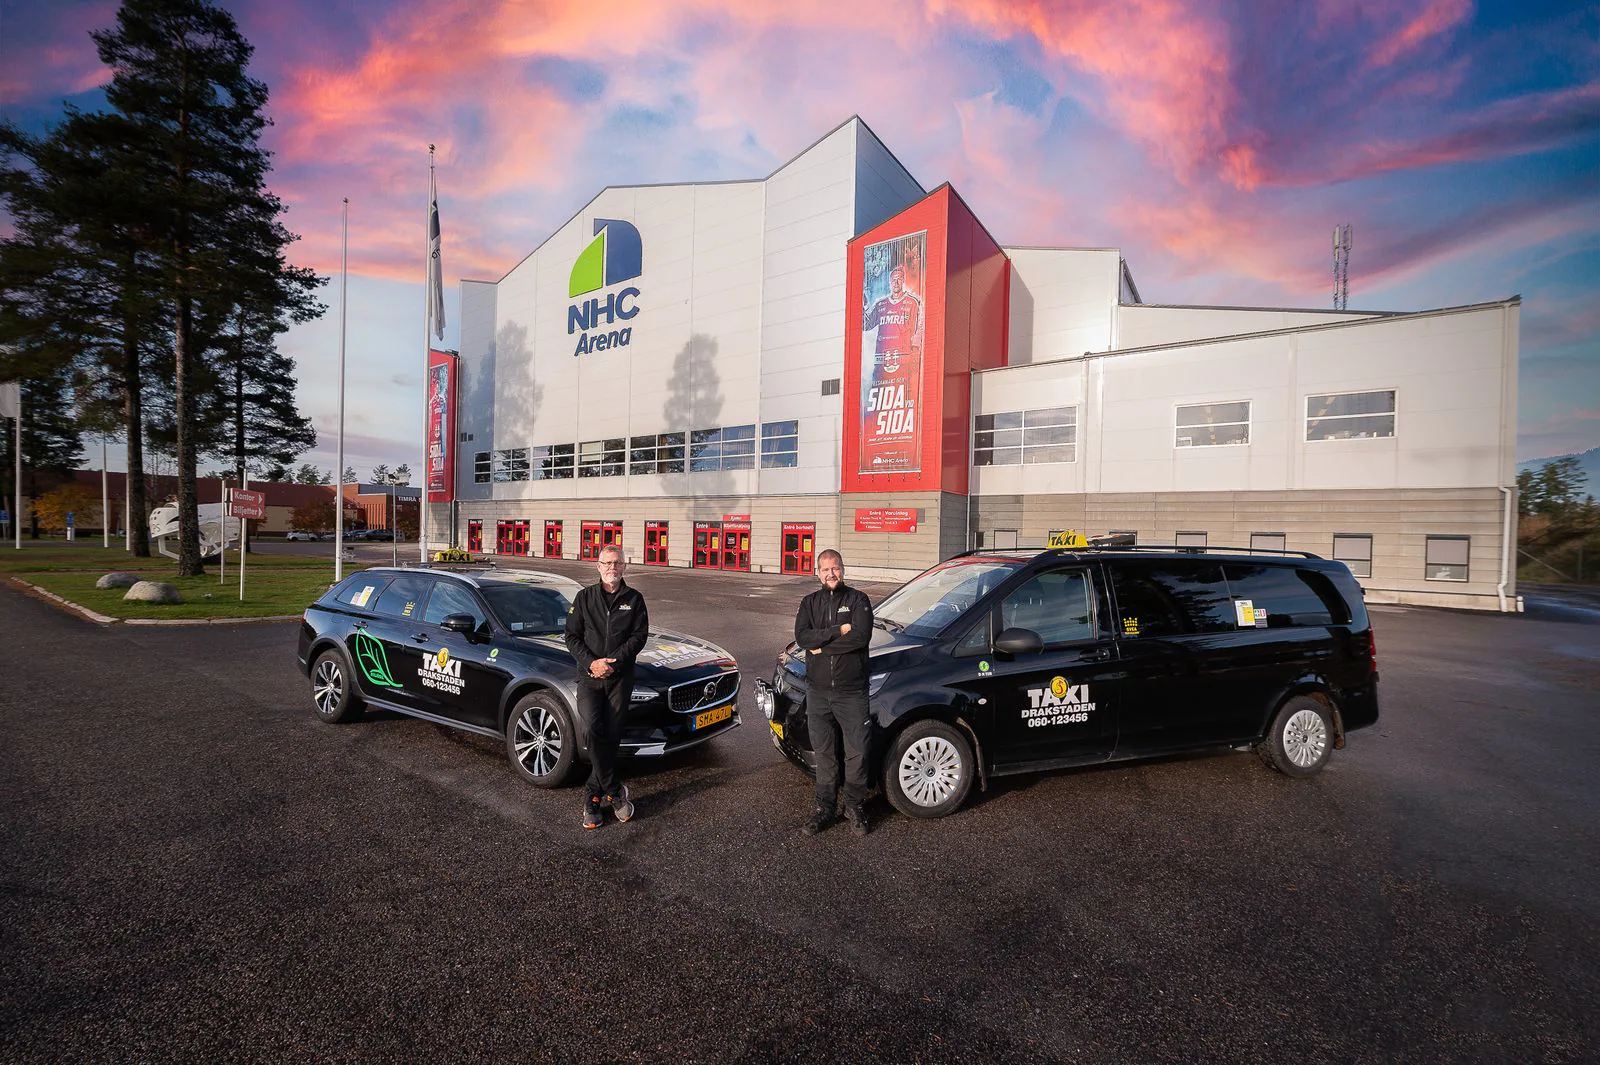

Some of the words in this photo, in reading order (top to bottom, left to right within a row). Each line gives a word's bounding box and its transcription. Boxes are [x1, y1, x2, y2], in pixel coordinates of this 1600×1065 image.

[567, 287, 641, 334] NHC
[574, 327, 632, 356] Arena
[867, 384, 905, 412] SIDA
[876, 409, 914, 435] SIDA
[234, 491, 255, 502] Kontor
[233, 505, 258, 516] Biljetter
[1051, 534, 1076, 546] TAXI
[422, 652, 462, 678] TAXI
[418, 668, 465, 687] DRAKSTADEN
[422, 678, 461, 695] 060-123456
[1027, 684, 1089, 708] TAXI
[1021, 702, 1096, 718] DRAKSTADEN
[1027, 713, 1088, 728] 060-123456
